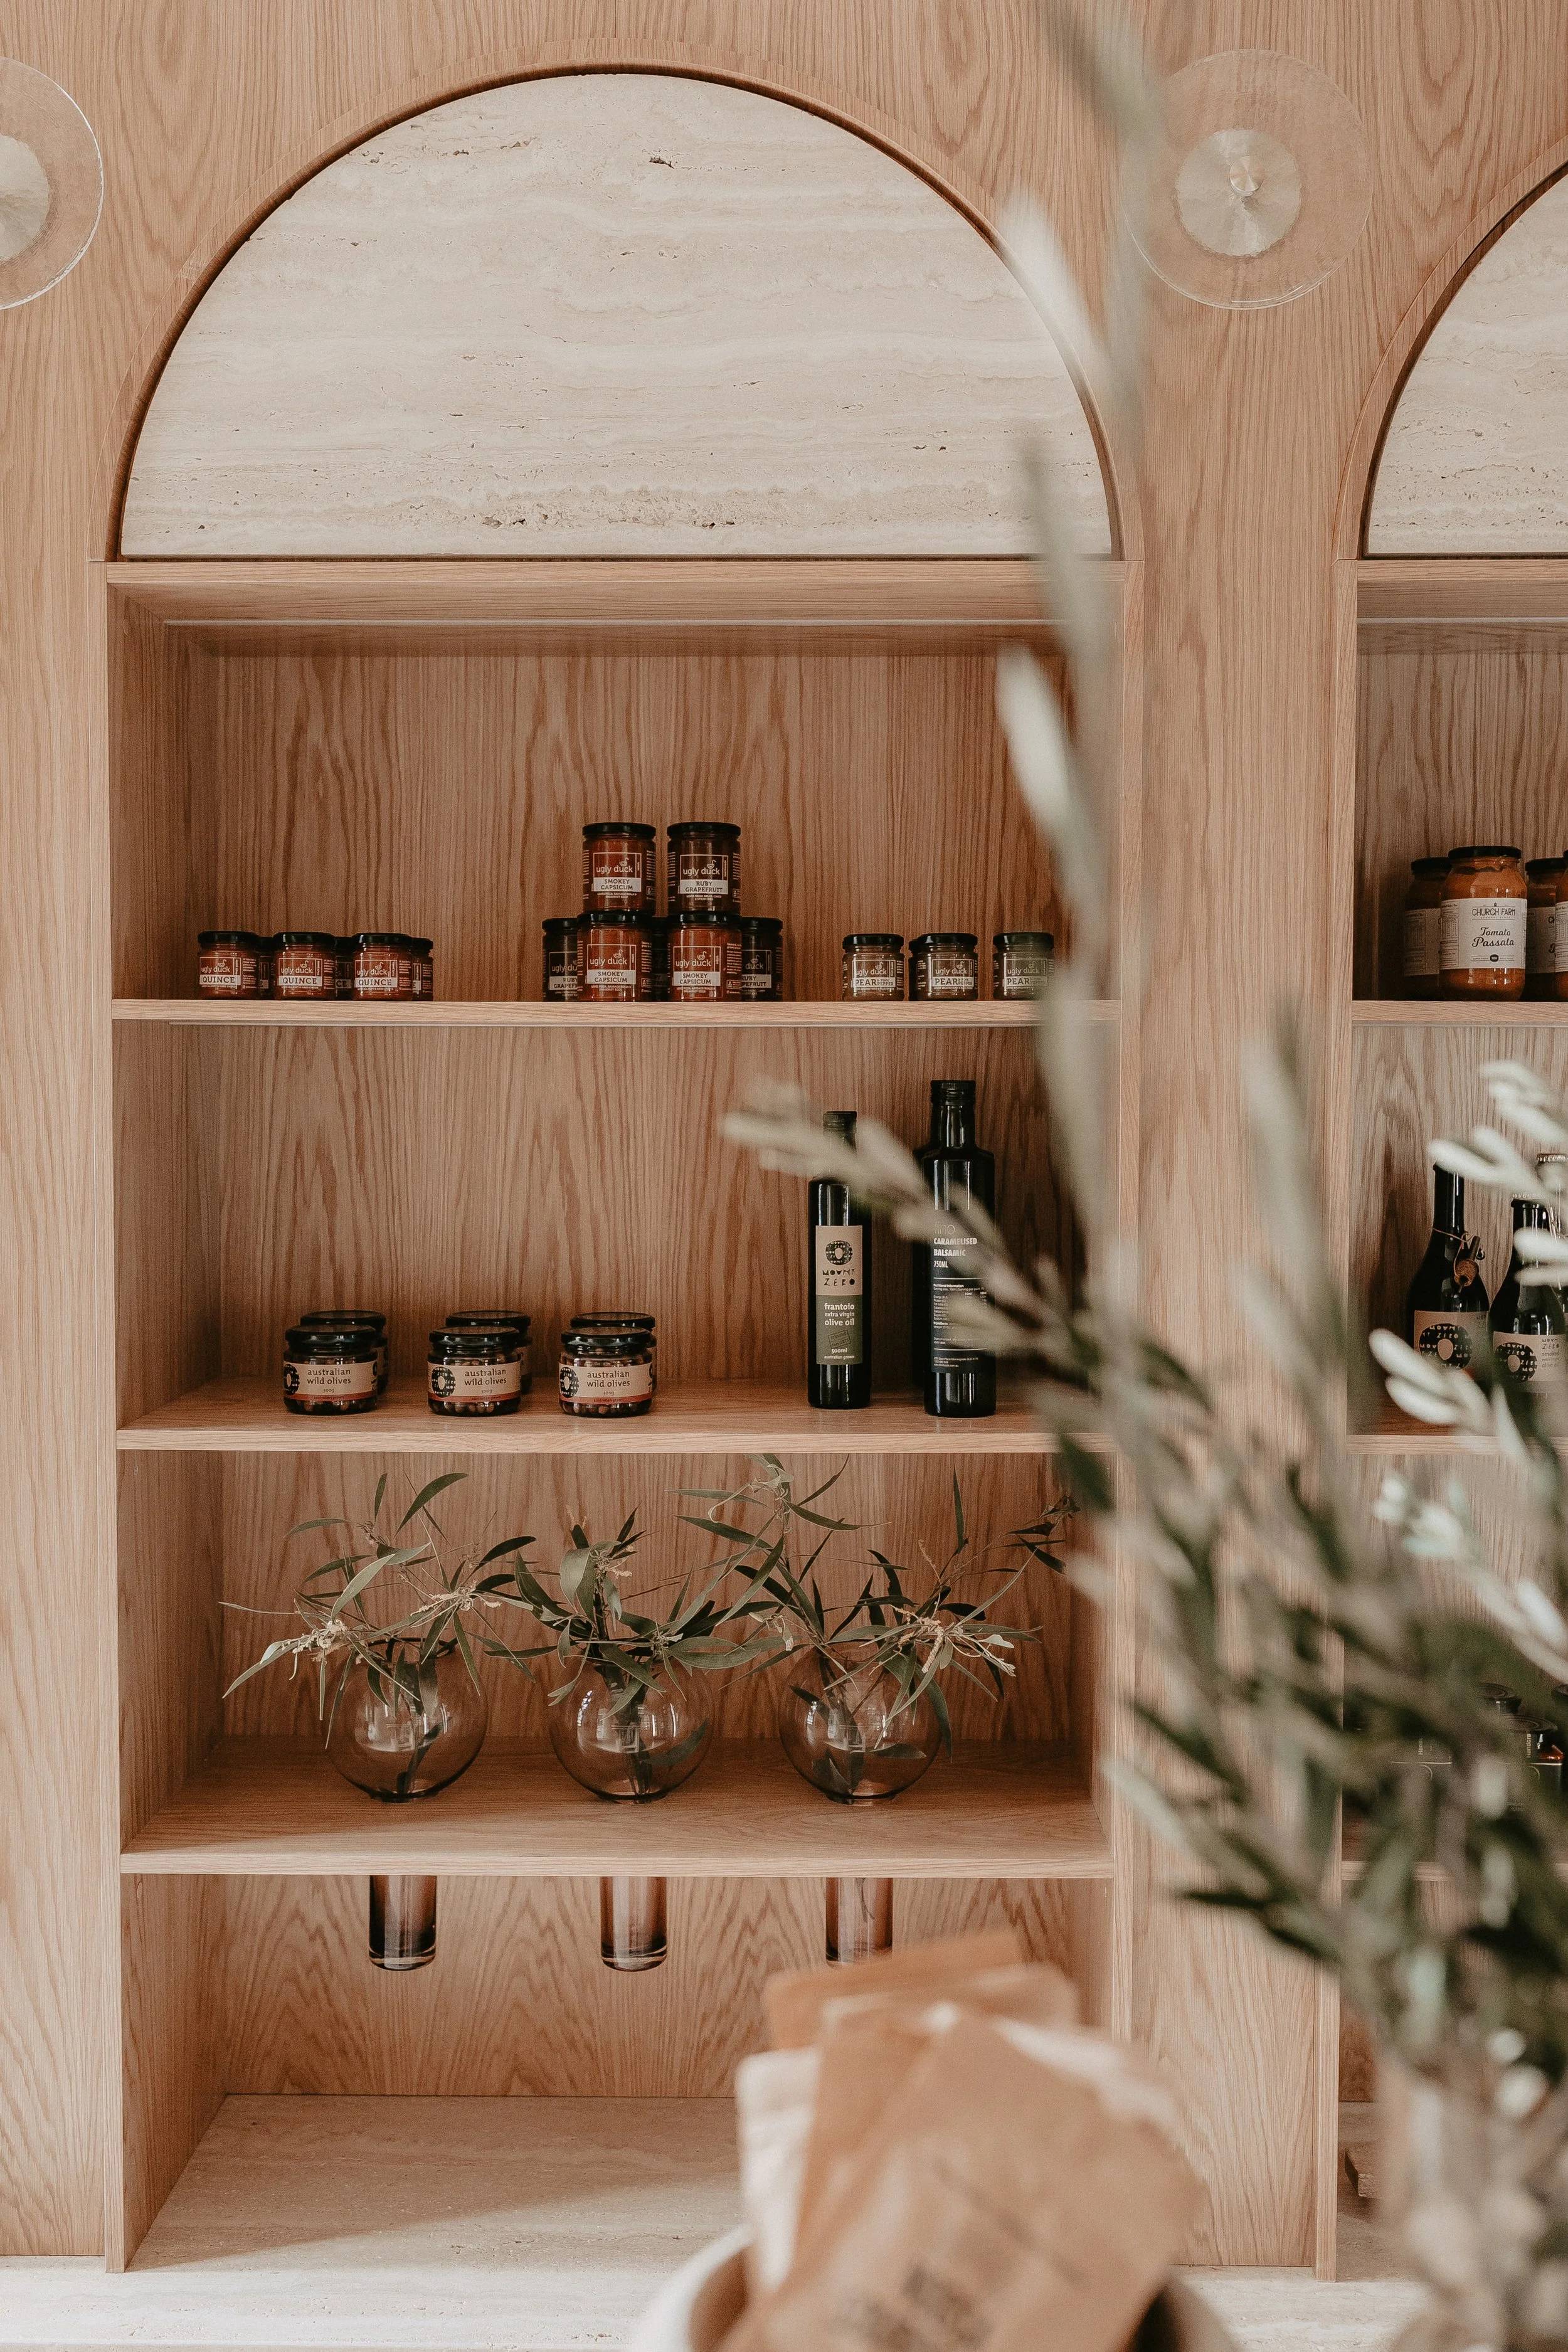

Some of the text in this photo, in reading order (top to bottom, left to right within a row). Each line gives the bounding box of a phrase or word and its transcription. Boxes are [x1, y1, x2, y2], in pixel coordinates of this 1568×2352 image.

[596, 866, 612, 874] ugly
[683, 867, 699, 876] ugly
[1480, 927, 1511, 936] Tomato
[1472, 936, 1515, 948] Passata
[590, 957, 605, 967] ugly
[675, 959, 690, 968] ugly
[551, 963, 565, 972] ugly
[465, 1369, 506, 1377] australian
